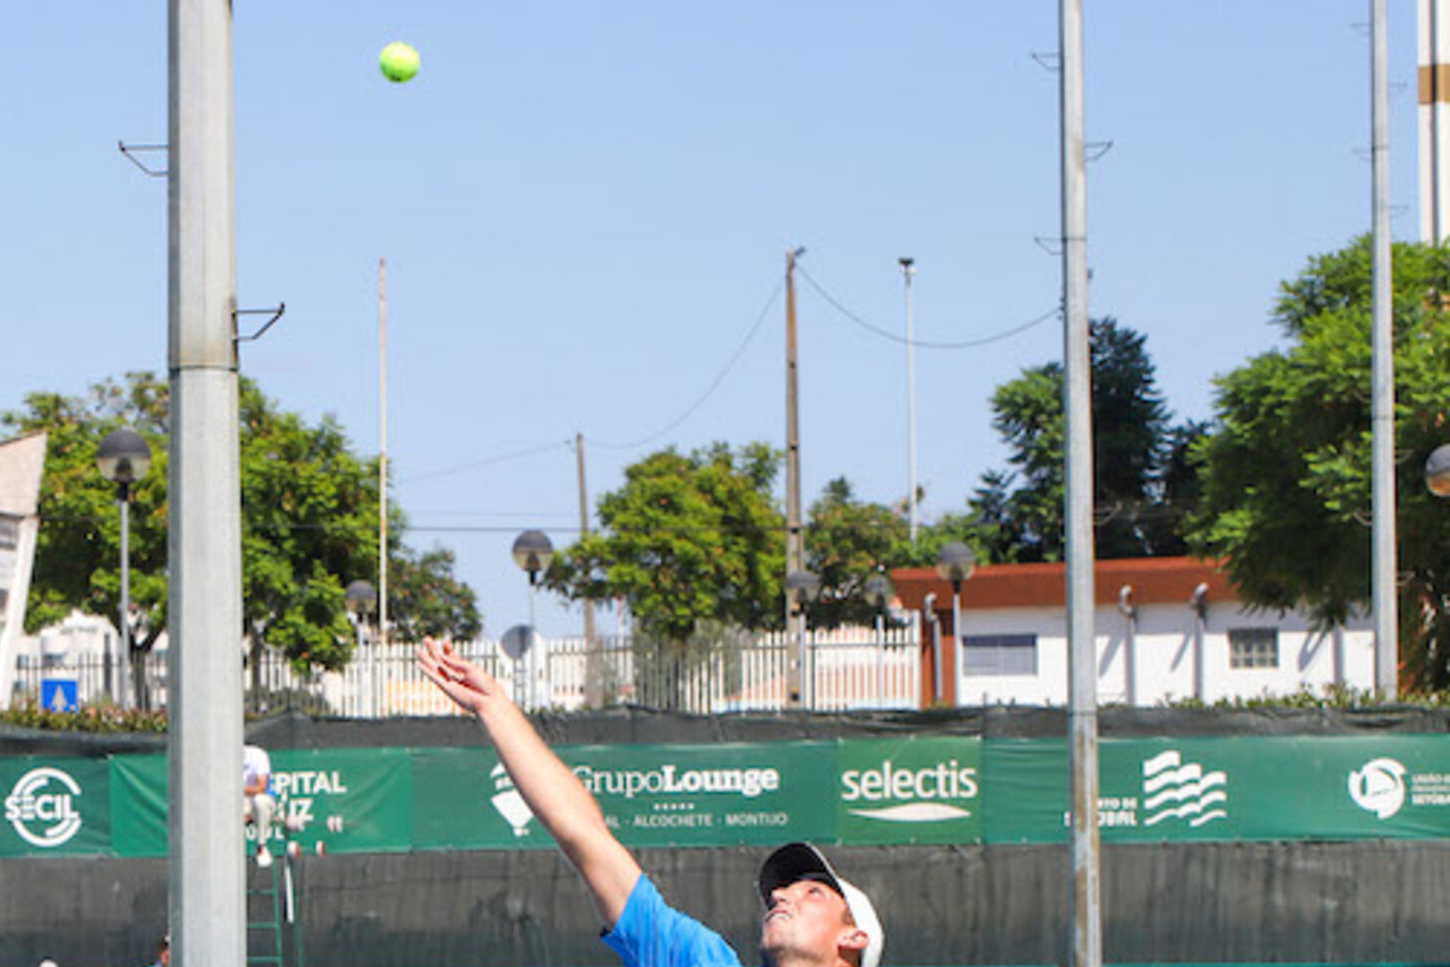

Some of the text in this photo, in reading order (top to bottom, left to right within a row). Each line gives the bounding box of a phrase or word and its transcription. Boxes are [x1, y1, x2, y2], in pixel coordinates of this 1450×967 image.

[272, 771, 347, 794] PITAL
[841, 760, 979, 800] selectis
[5, 794, 80, 820] SECIL
[724, 811, 788, 826] MONTIJO
[632, 813, 713, 827] ALCOCHETE
